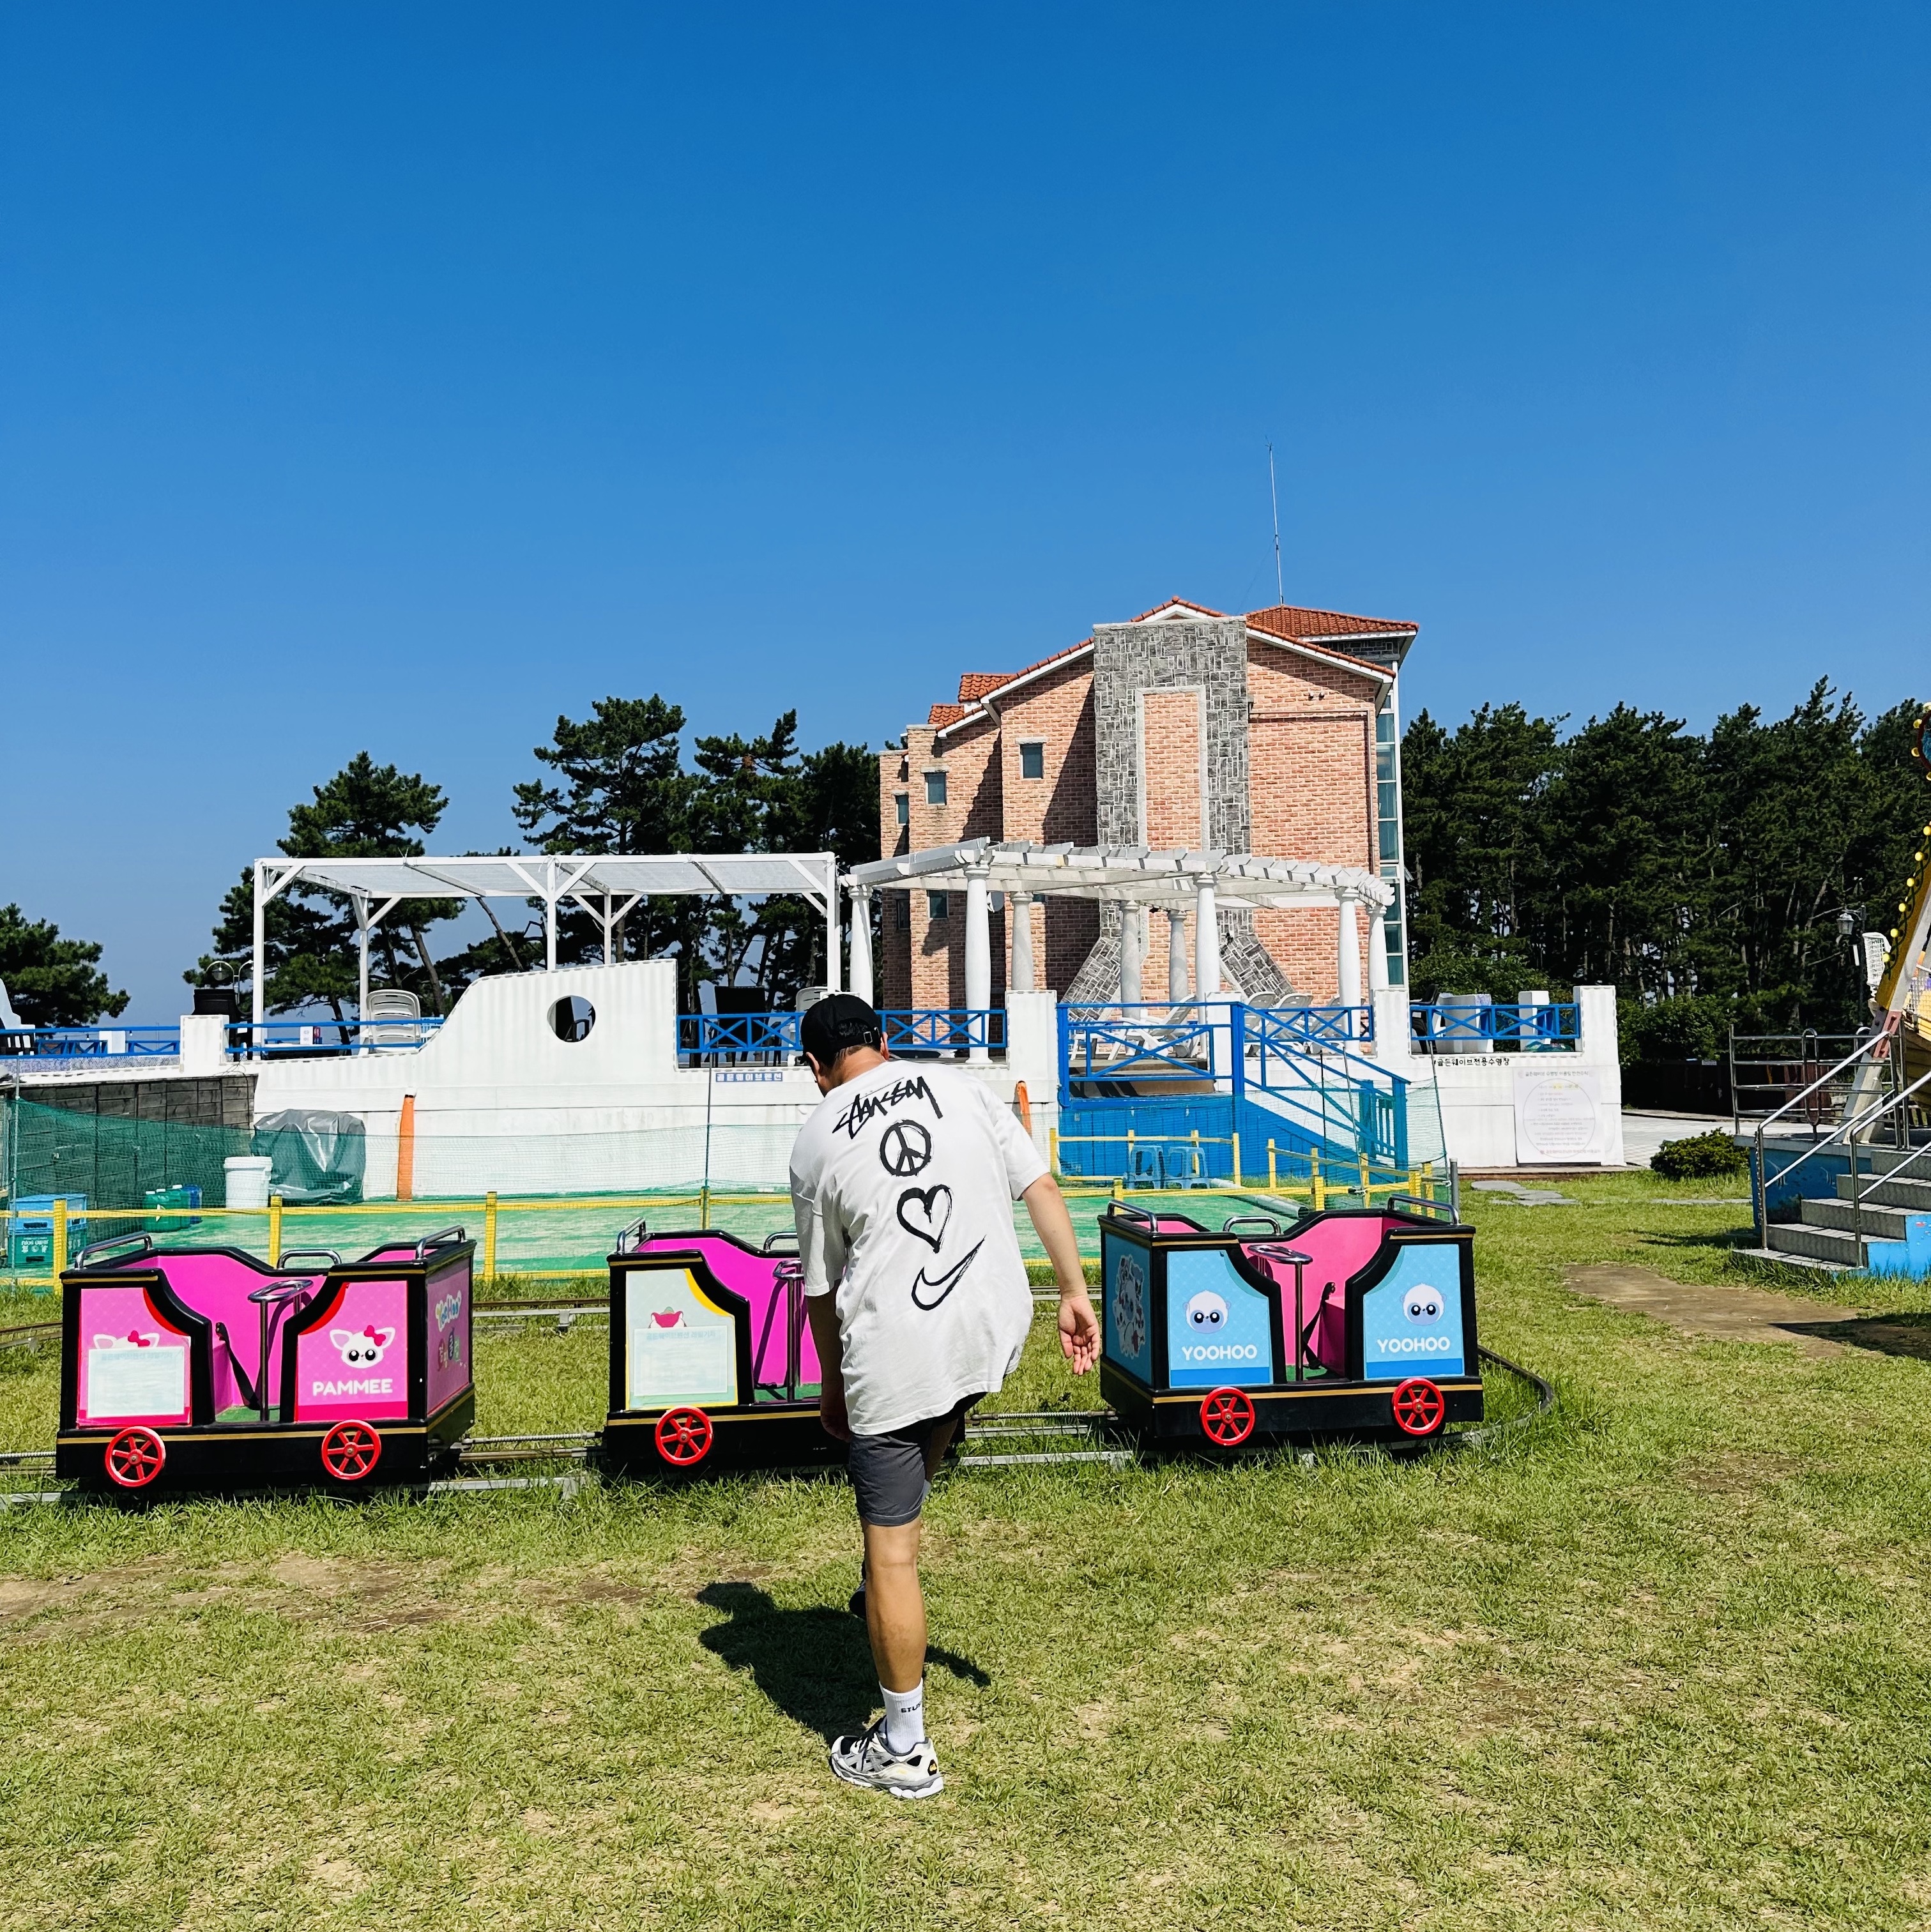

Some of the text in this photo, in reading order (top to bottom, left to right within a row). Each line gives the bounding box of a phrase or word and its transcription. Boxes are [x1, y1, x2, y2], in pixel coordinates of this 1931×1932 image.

[716, 1072, 782, 1081] 골든웨이브펜션
[1181, 1344, 1258, 1361] YOOHOO
[1377, 1336, 1451, 1353] YOOHOO
[312, 1378, 393, 1397] PAMMEE
